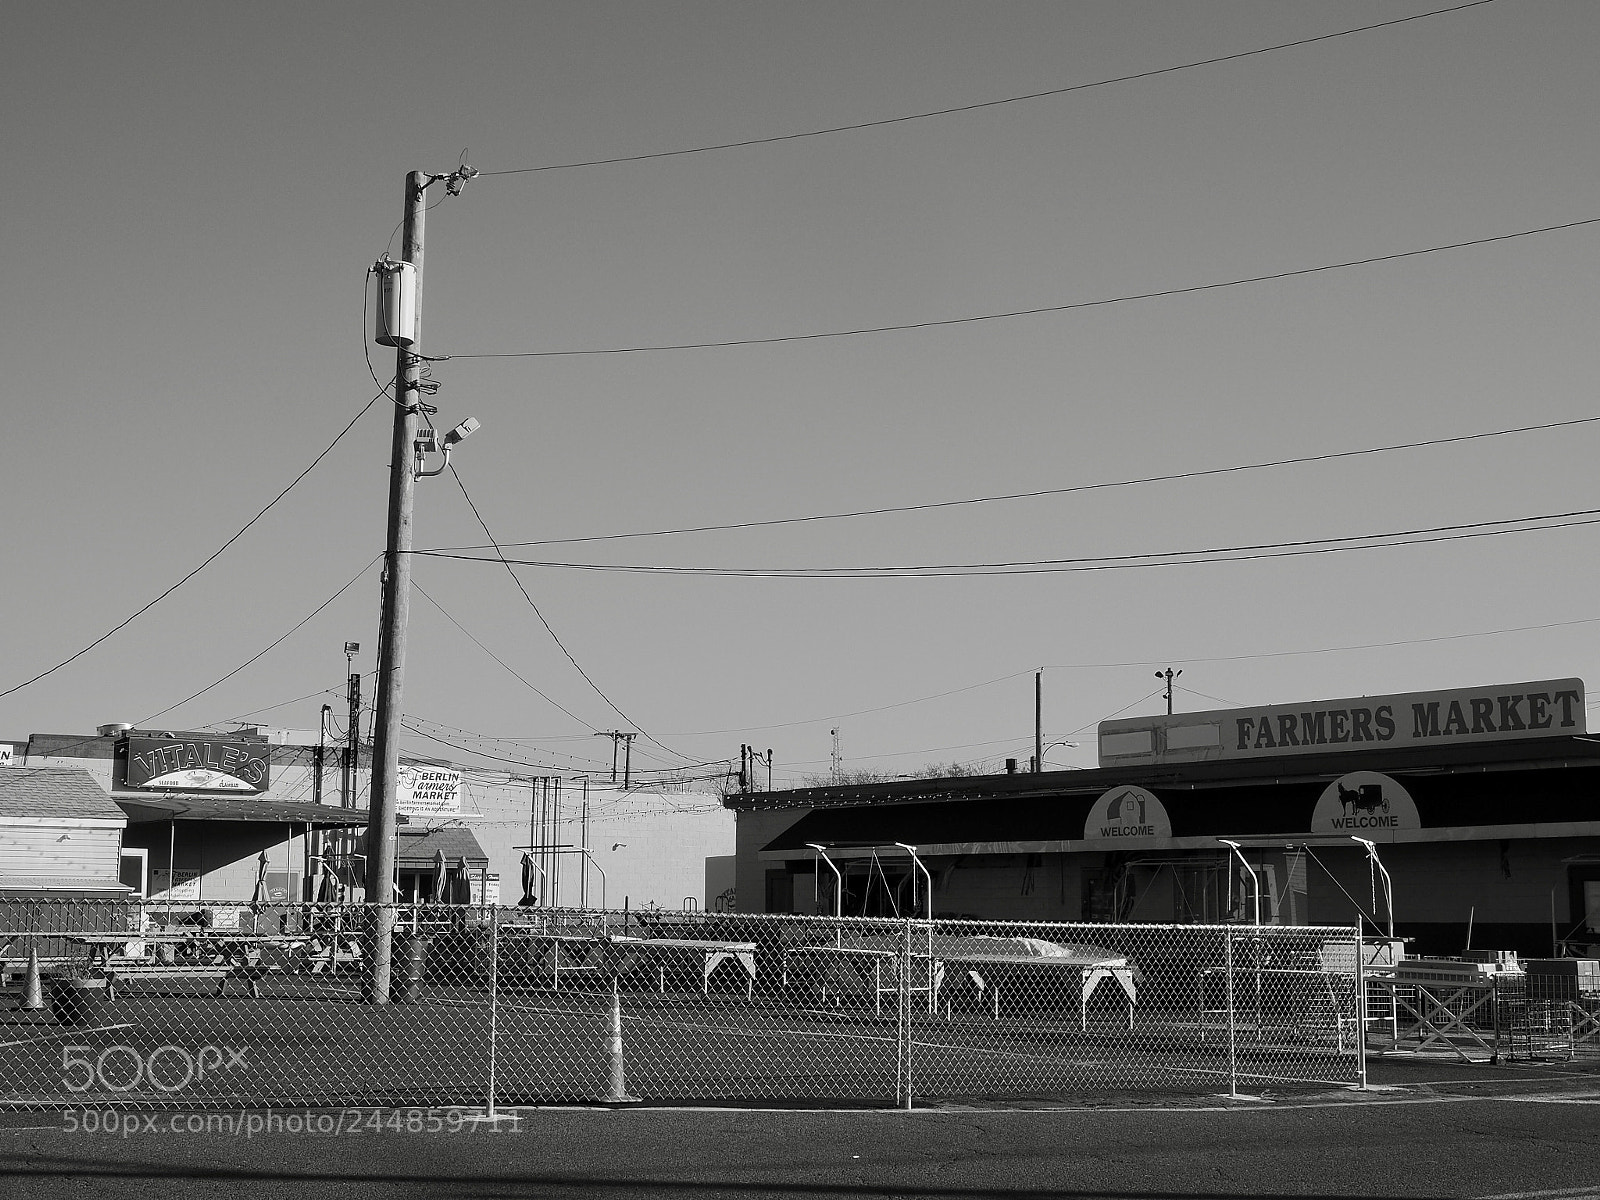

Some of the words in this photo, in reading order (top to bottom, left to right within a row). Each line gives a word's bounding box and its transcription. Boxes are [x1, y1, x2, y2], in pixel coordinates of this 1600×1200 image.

[1236, 705, 1396, 750] FARMERS
[1411, 689, 1581, 738] MARKET
[133, 743, 267, 784] VITALE'S
[421, 772, 459, 782] BERLIN
[412, 791, 457, 800] MARKET
[1331, 816, 1399, 829] WELCOME
[1101, 826, 1155, 837] WELCOME
